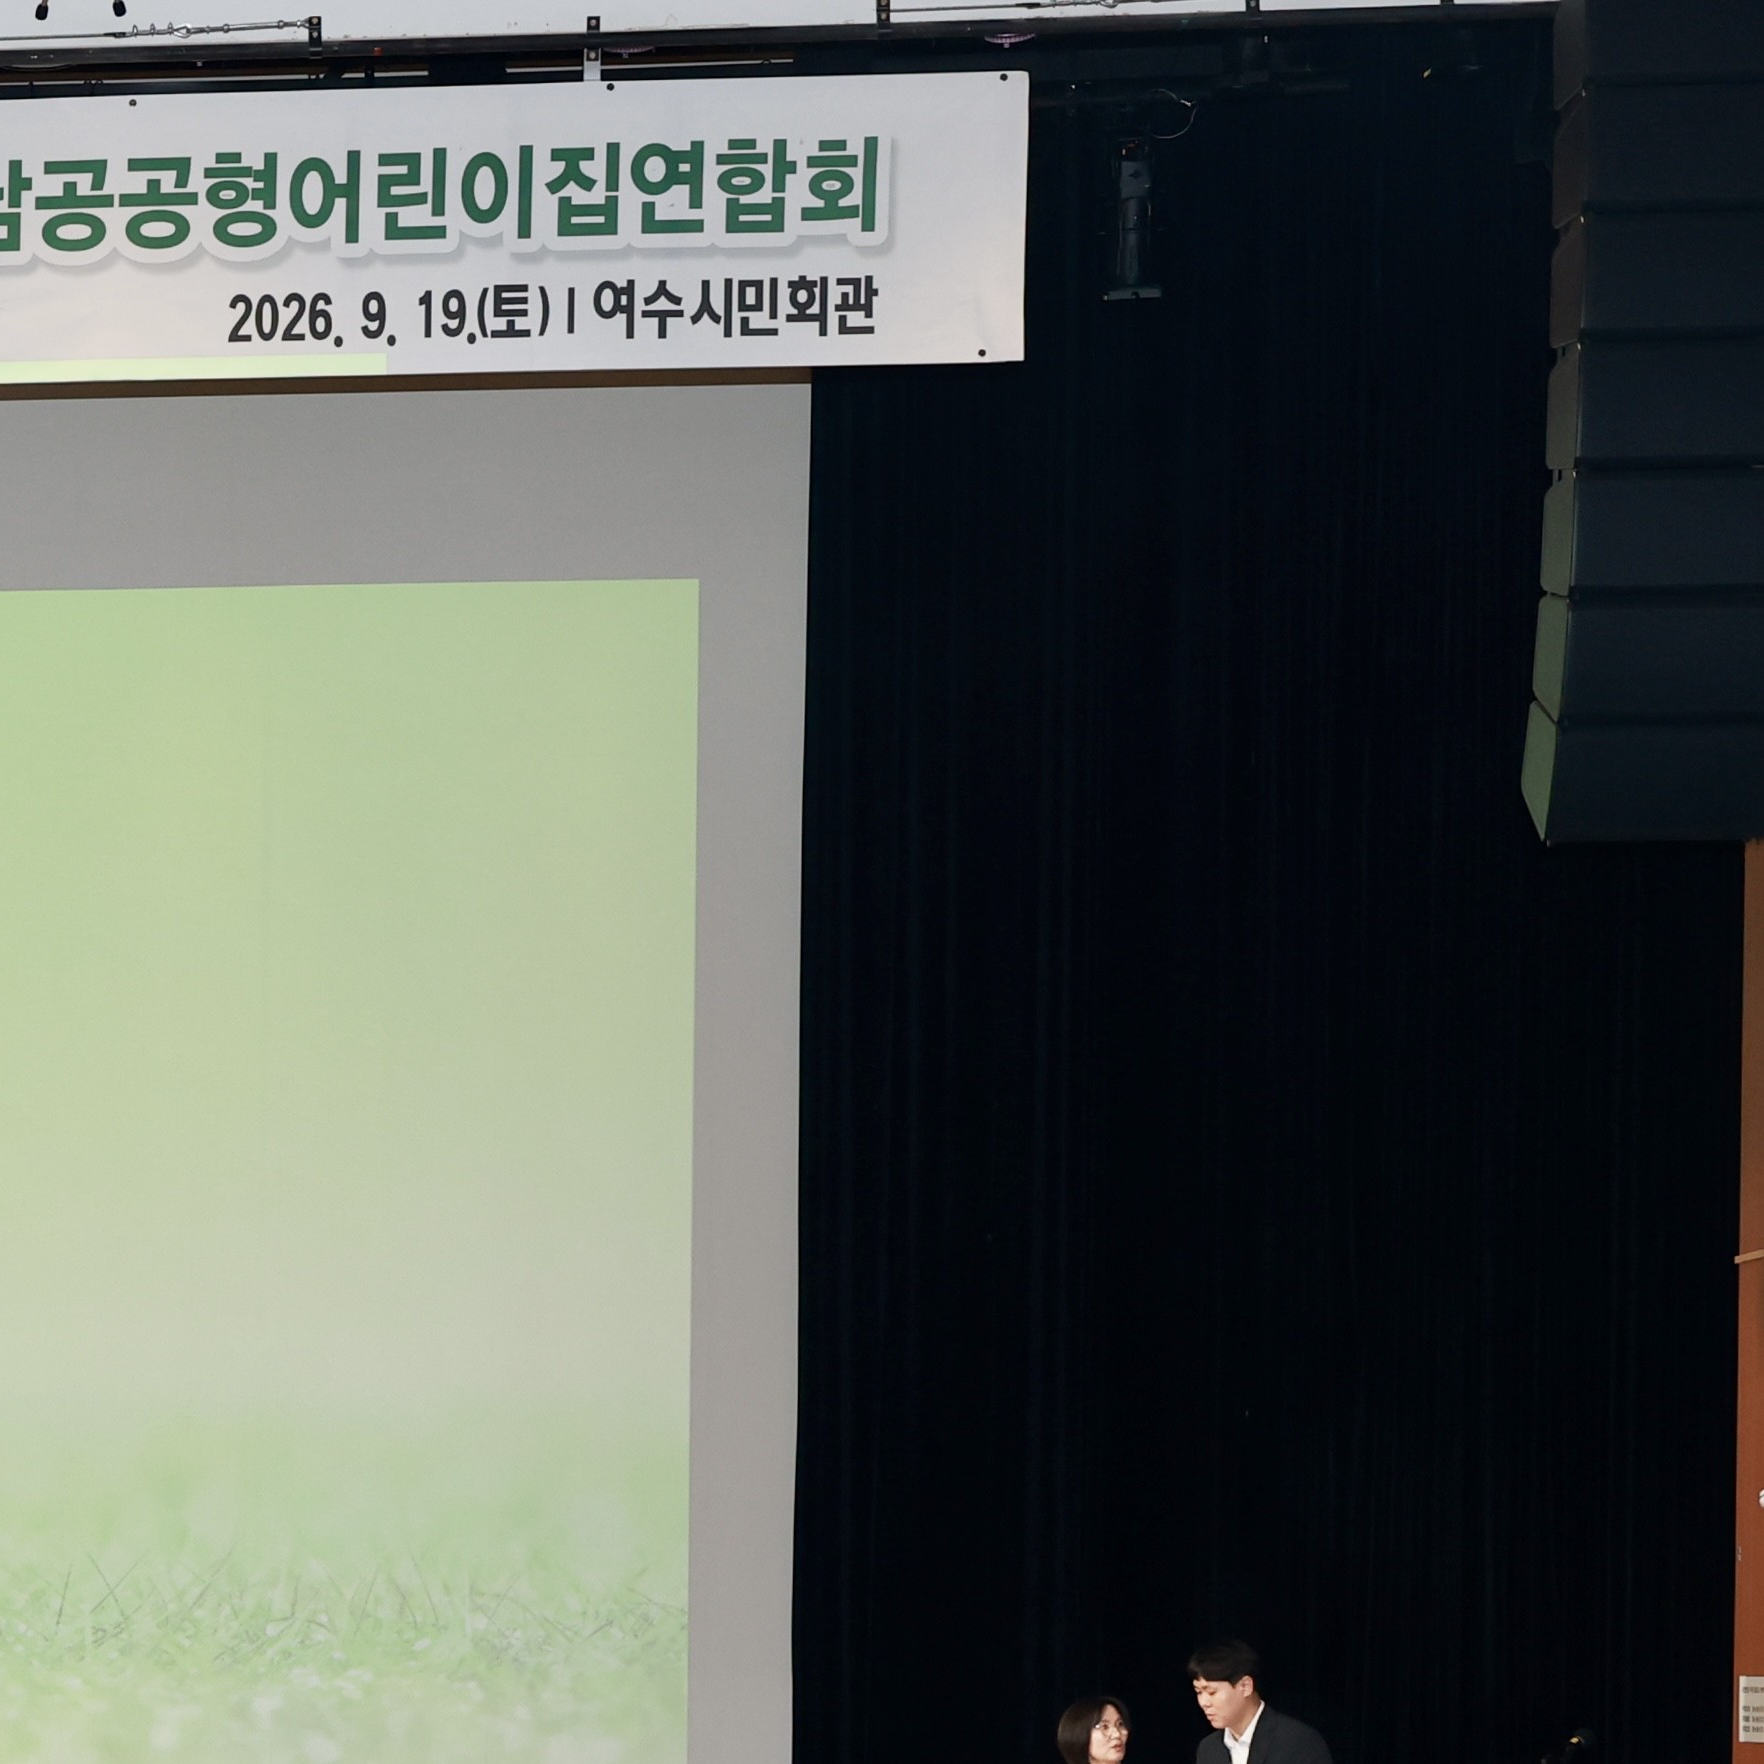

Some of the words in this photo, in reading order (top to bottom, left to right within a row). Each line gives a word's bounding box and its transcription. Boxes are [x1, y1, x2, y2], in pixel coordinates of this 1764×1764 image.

[228, 292, 343, 347] 2026.
[361, 291, 396, 346] 9.
[593, 275, 878, 339] 여수시민회관
